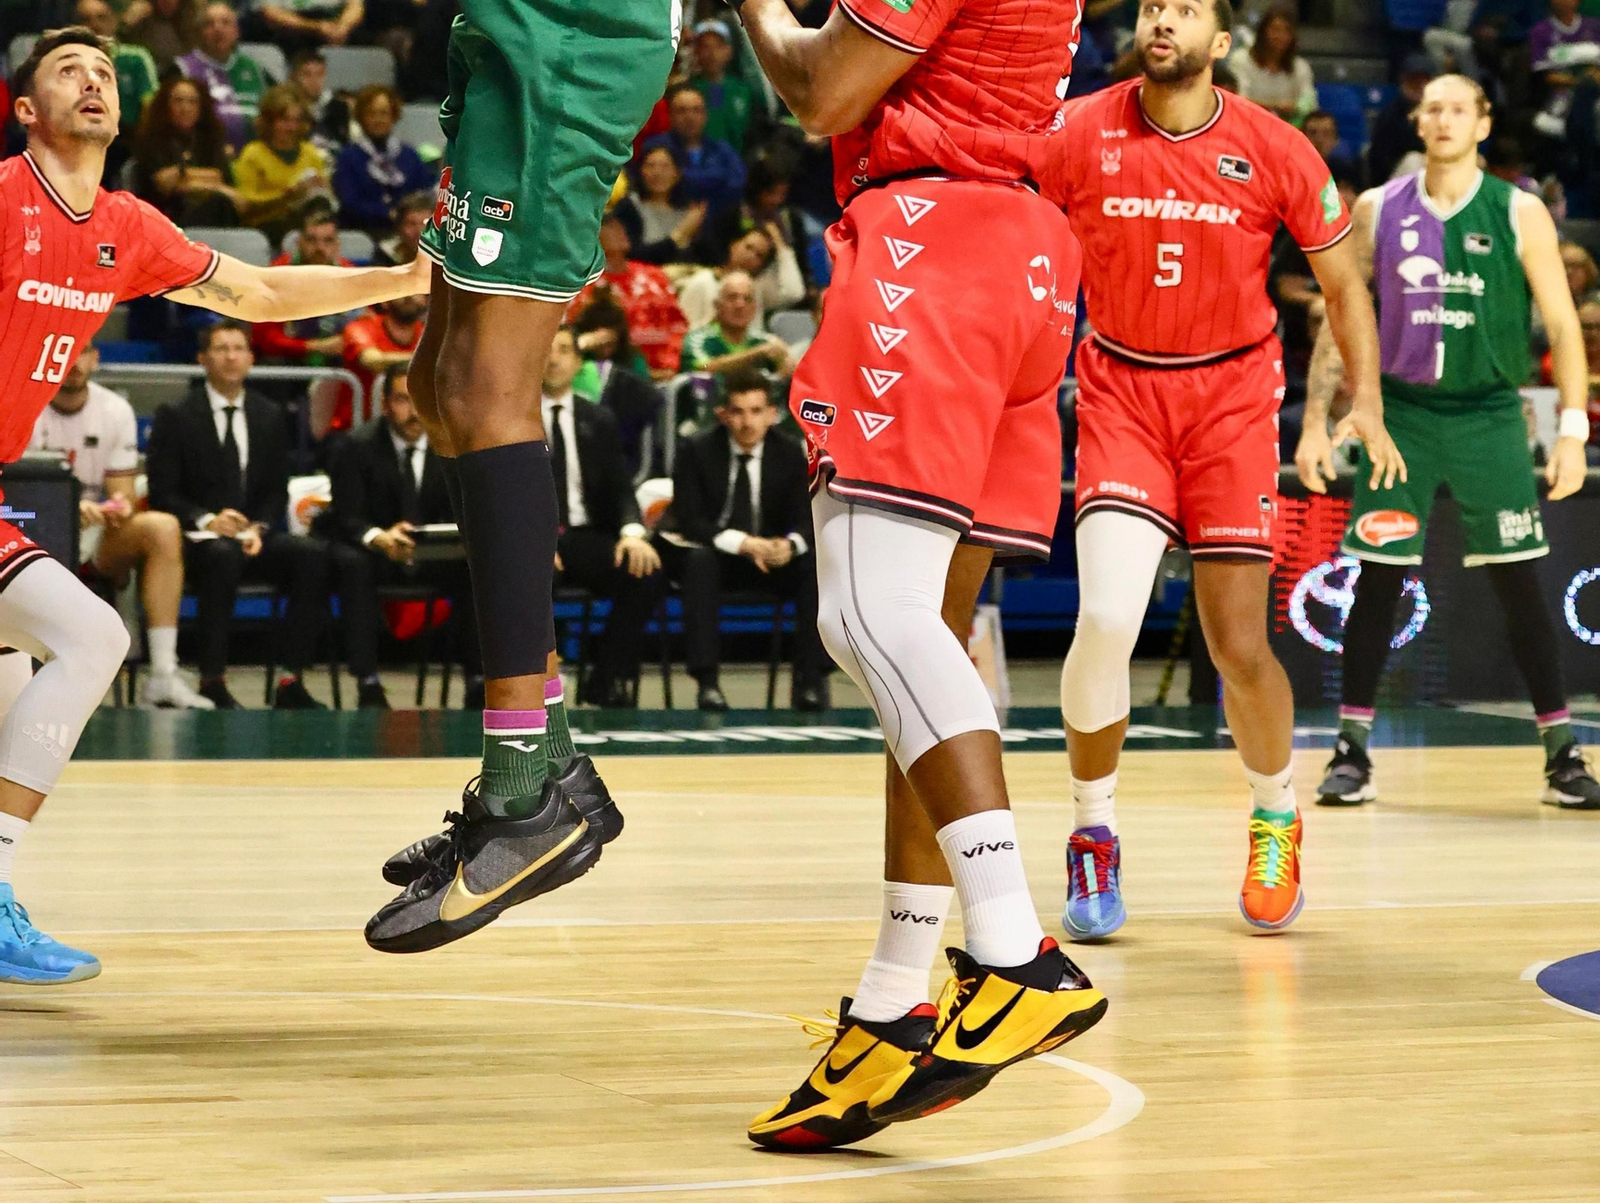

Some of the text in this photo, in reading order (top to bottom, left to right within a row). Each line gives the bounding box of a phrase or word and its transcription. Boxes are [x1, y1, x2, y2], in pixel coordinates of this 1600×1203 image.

[484, 205, 504, 218] acb
[1102, 188, 1242, 226] COVIRAN
[1154, 242, 1185, 289] 5
[17, 276, 115, 314] COVIRAN
[31, 333, 76, 385] 19
[1434, 340, 1445, 380] 1
[803, 410, 828, 423] acb
[21, 724, 66, 764] adidas
[962, 840, 1015, 859] vive
[890, 909, 939, 925] vive
